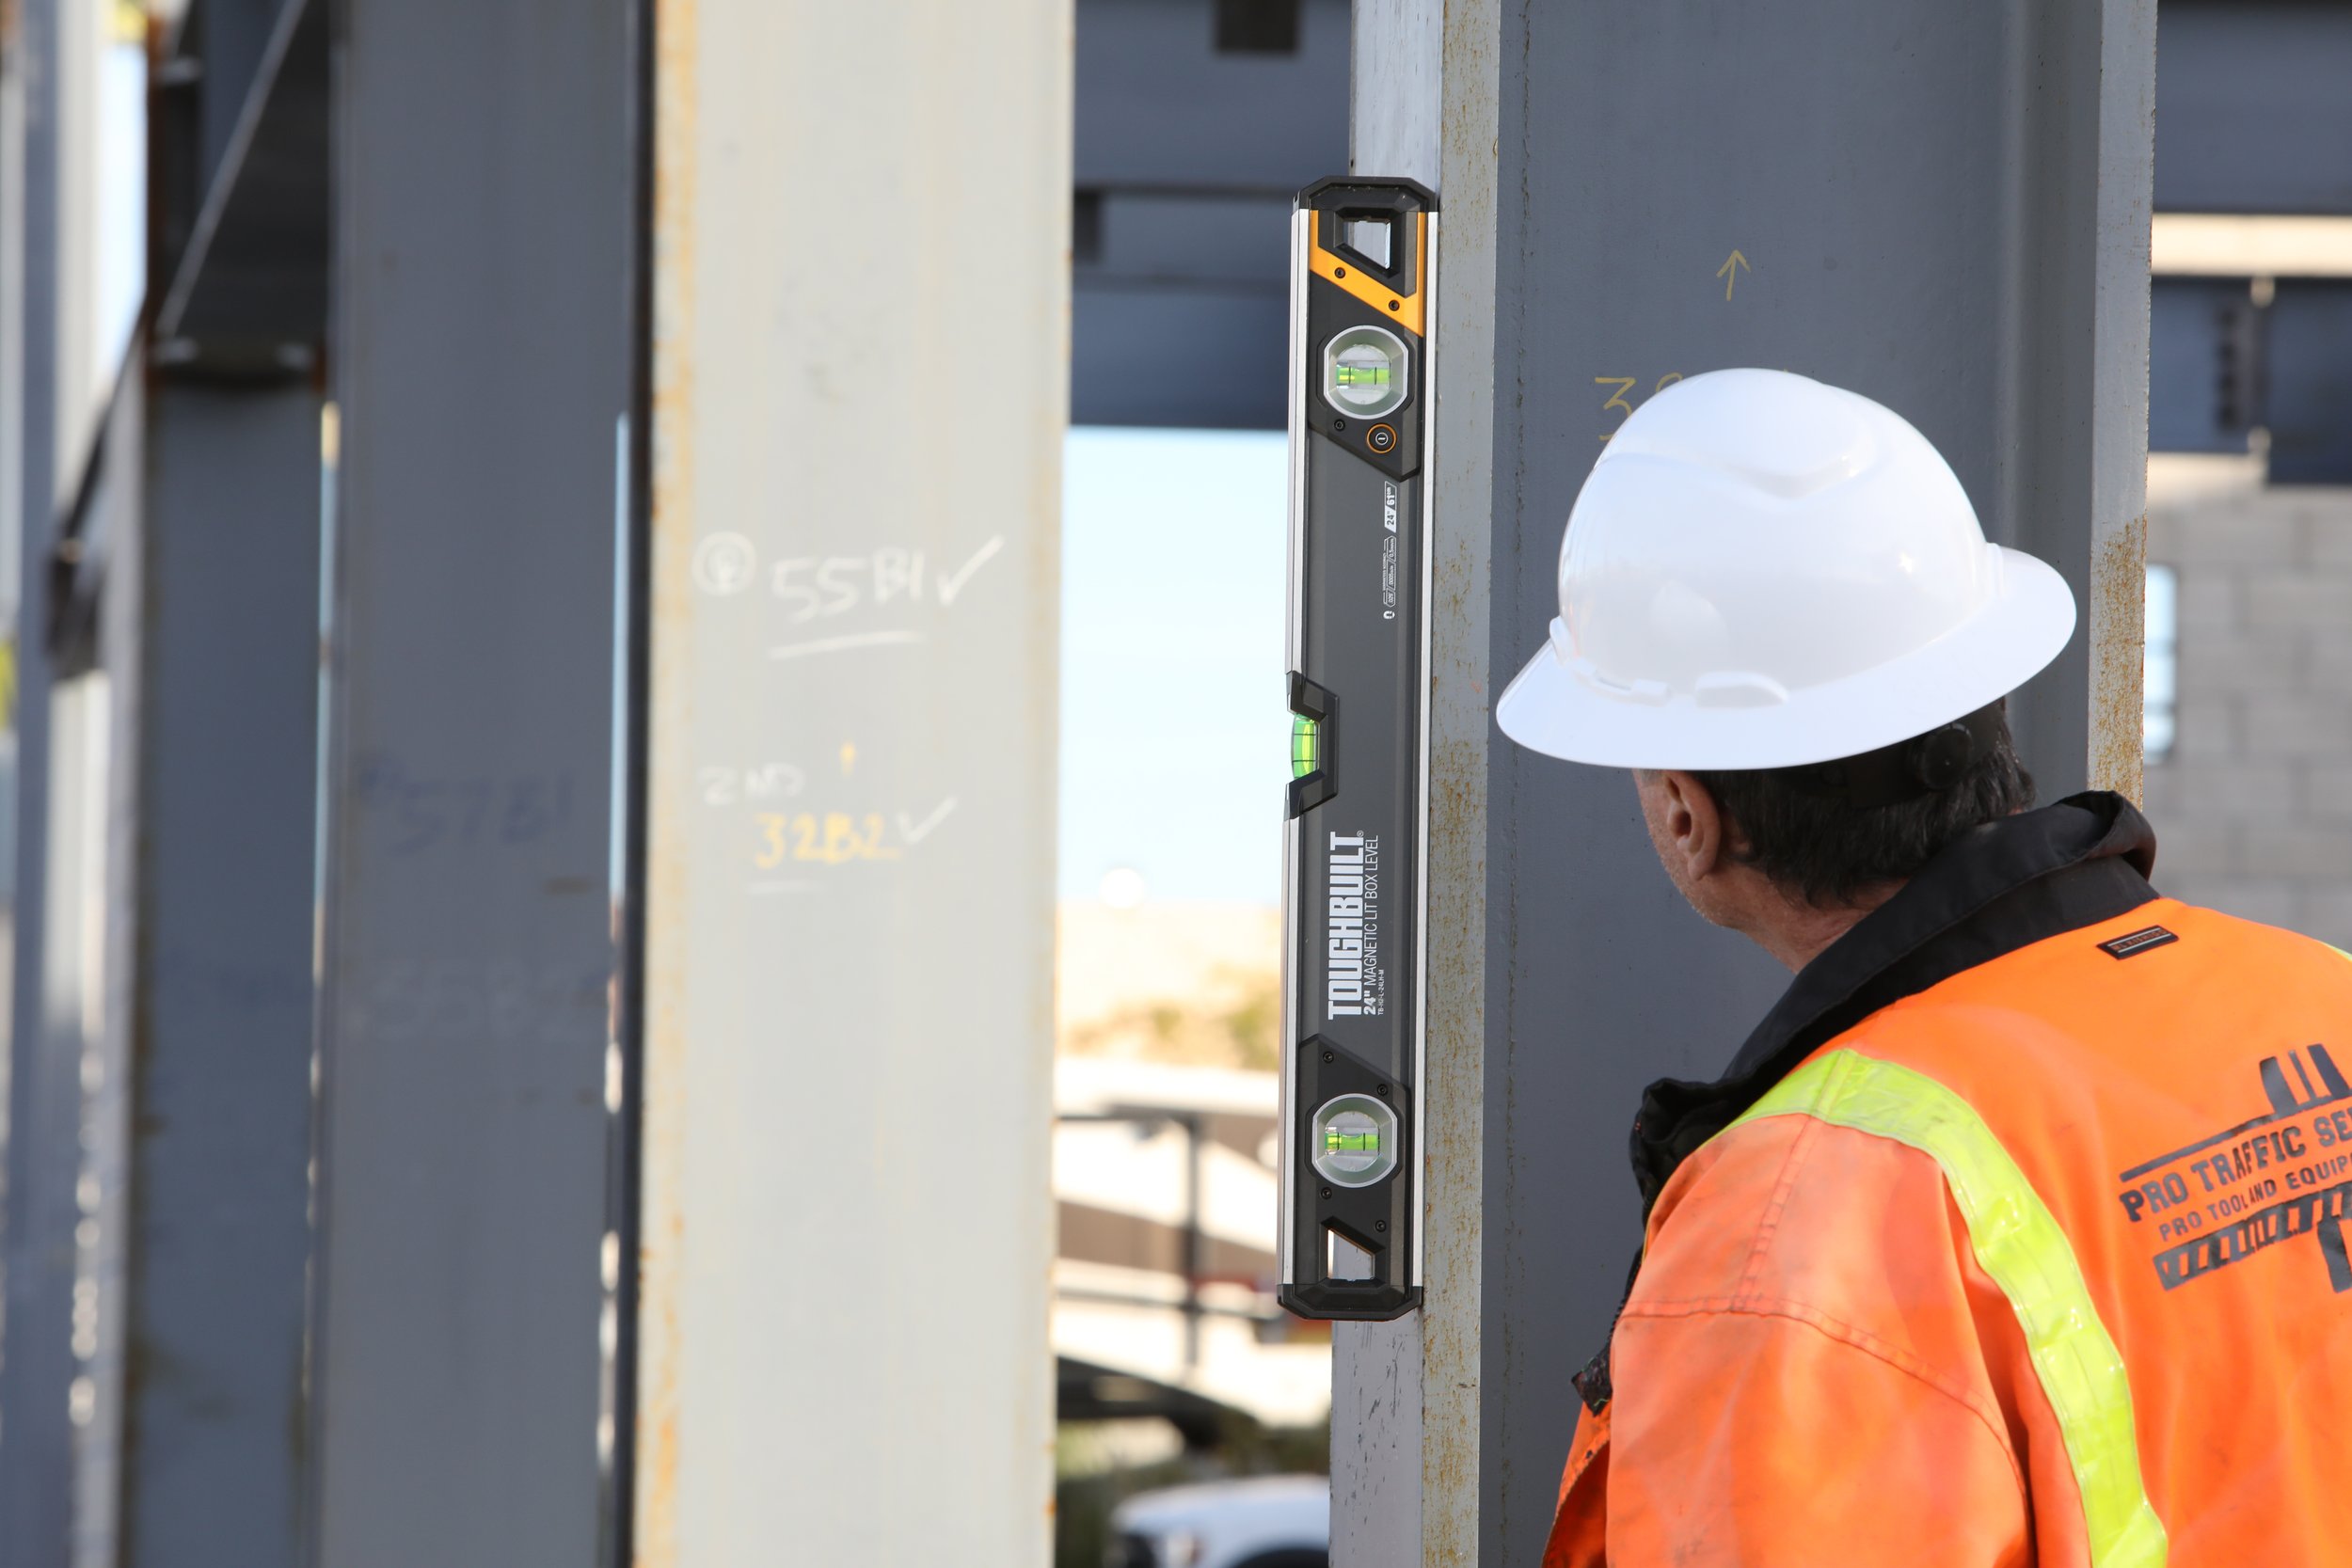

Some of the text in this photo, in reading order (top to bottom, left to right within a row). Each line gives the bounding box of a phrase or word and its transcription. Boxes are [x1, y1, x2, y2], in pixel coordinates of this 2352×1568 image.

[755, 811, 901, 870] 32B2
[1327, 831, 1364, 1021] TOUGHBUILT
[1363, 834, 1379, 1016] 24" MAGNETIC LIT BOX LEVEL
[2119, 1105, 2352, 1223] PRO TRAFFIC SE
[2158, 1152, 2352, 1242] PRO TOOL AND EQUIP
